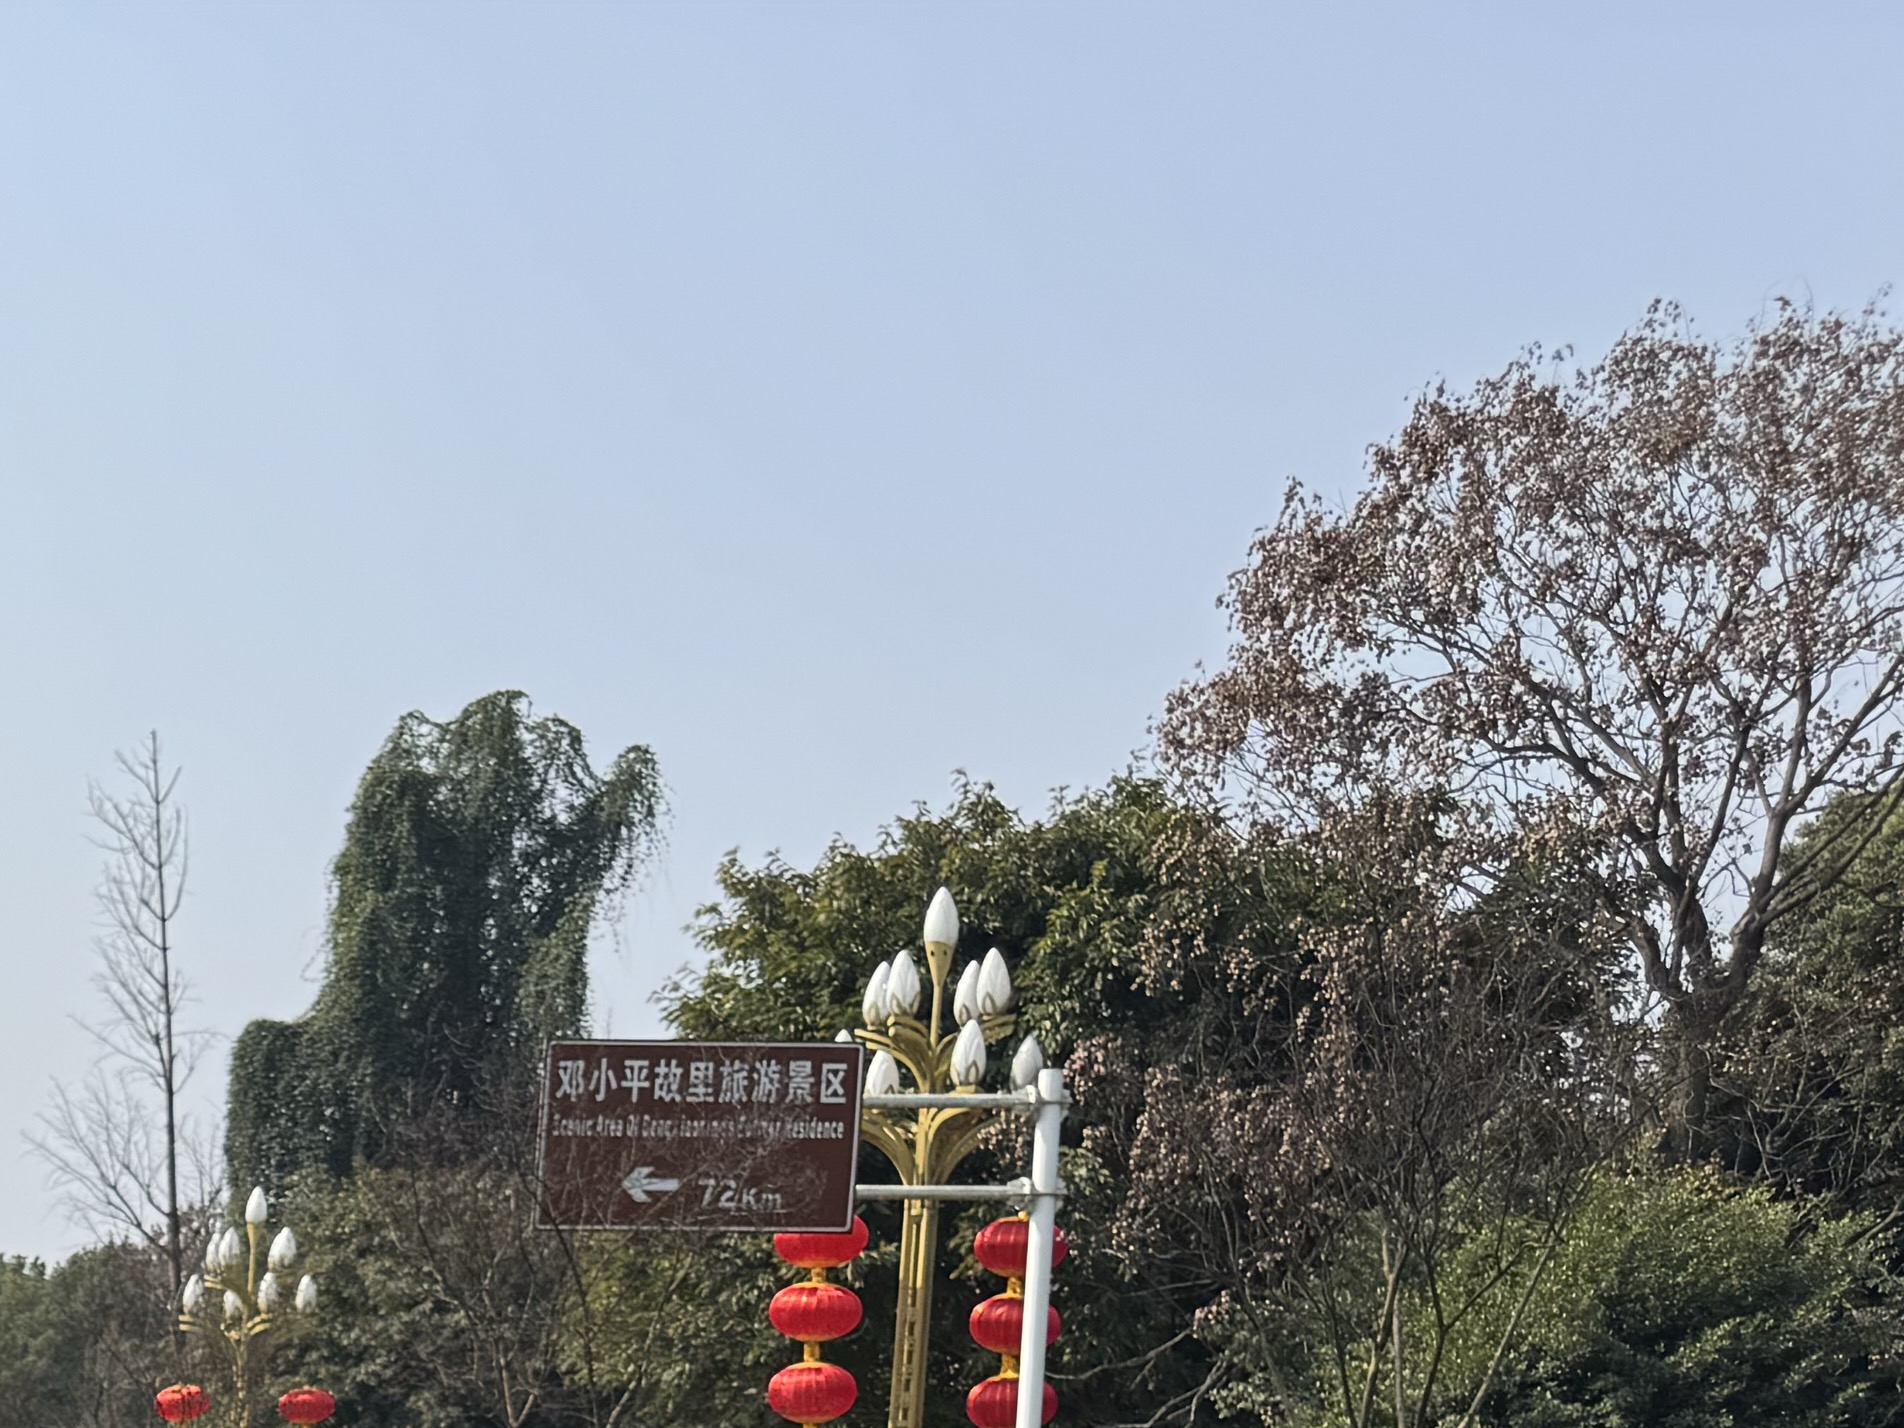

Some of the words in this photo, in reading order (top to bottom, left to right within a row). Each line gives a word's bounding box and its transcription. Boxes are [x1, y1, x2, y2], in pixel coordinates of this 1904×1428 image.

[555, 1057, 848, 1104] 邓小平故里旅游景区
[596, 1113, 623, 1137] Area
